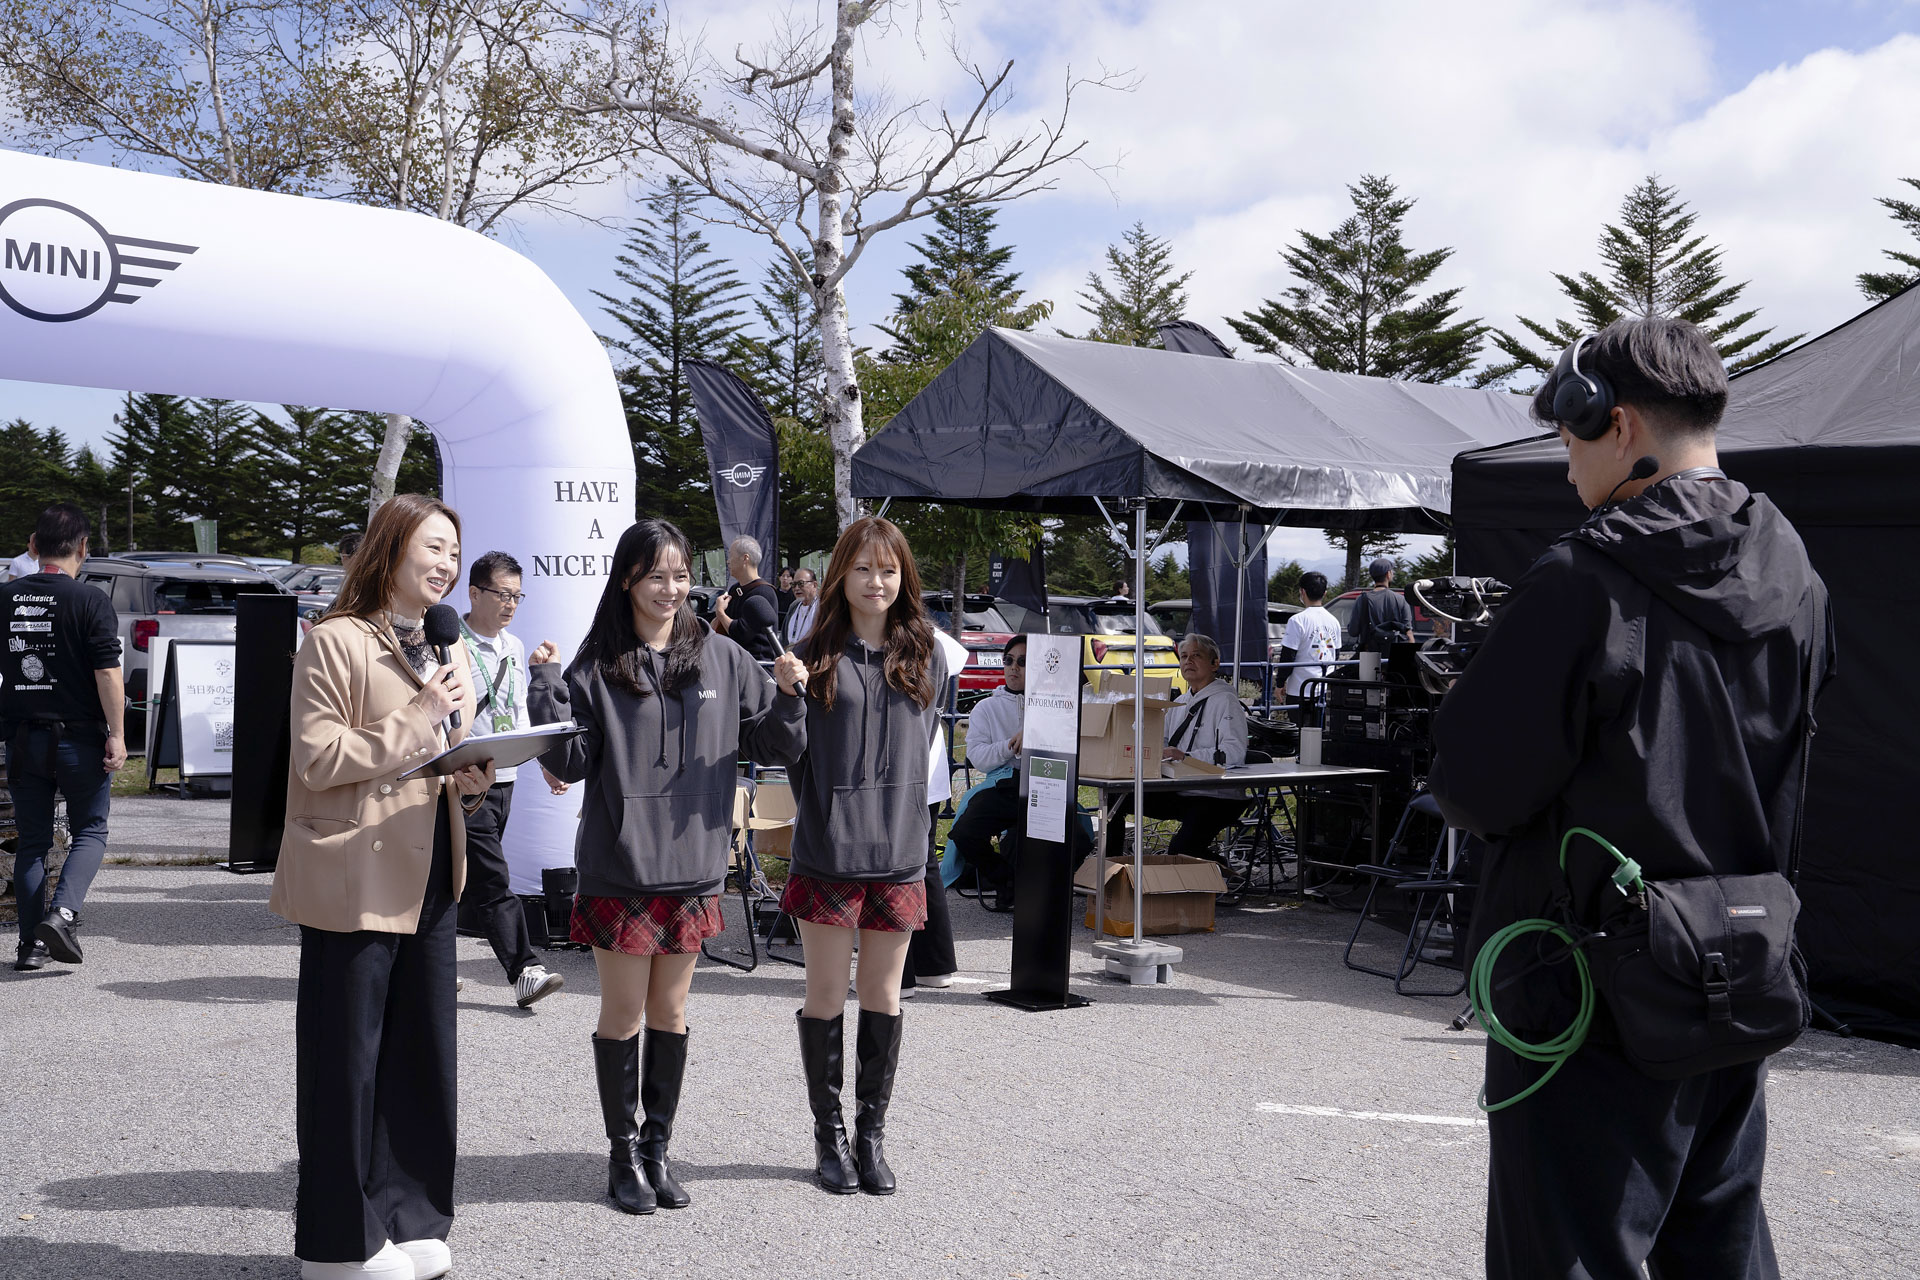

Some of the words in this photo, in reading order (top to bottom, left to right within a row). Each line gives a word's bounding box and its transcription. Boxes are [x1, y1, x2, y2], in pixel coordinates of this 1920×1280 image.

[5, 238, 101, 281] MINI
[554, 481, 619, 503] HAVE
[587, 518, 605, 540] A
[532, 555, 596, 577] NICE
[602, 555, 614, 576] D
[698, 689, 717, 700] MINI
[1028, 697, 1074, 710] INFORMATION
